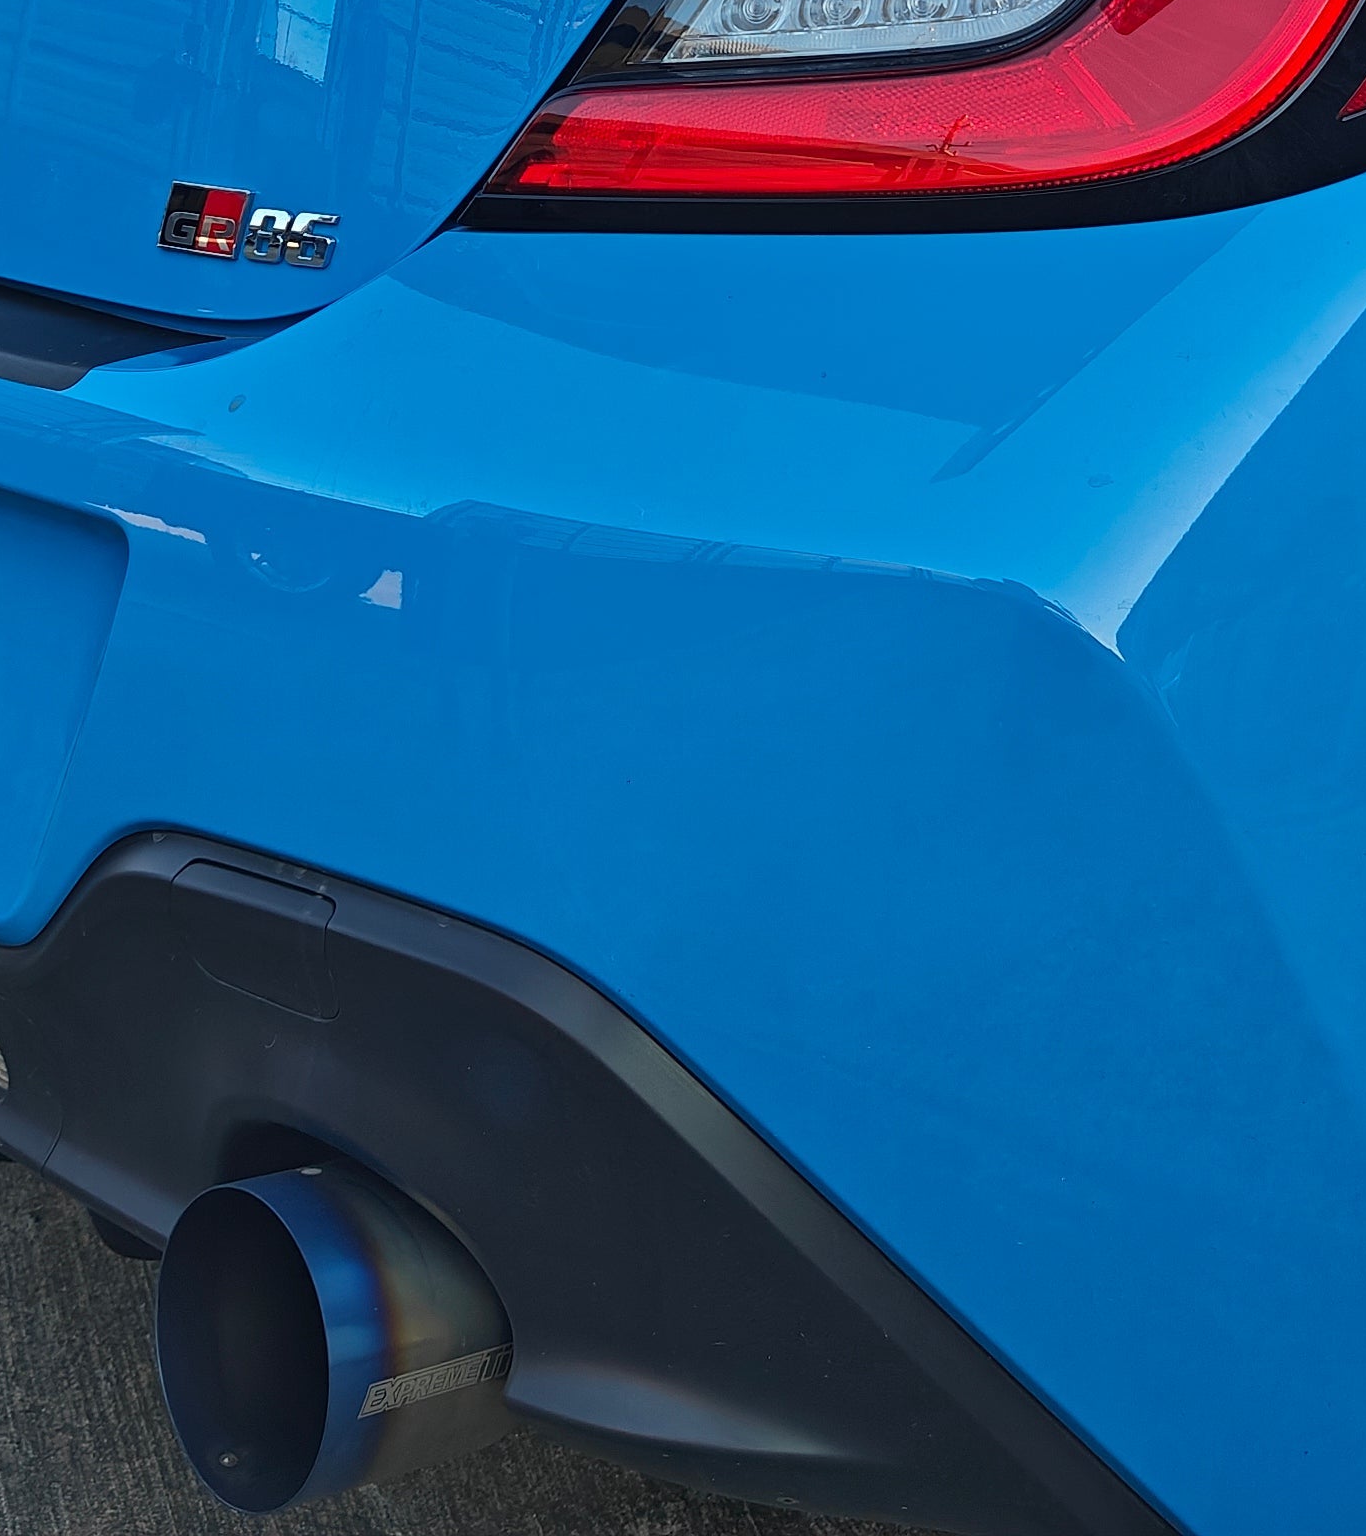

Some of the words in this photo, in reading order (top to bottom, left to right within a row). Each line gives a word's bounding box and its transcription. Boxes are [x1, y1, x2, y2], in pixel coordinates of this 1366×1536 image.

[164, 211, 236, 252] GR
[243, 207, 341, 268] 86
[359, 1353, 483, 1417] EXPREME
